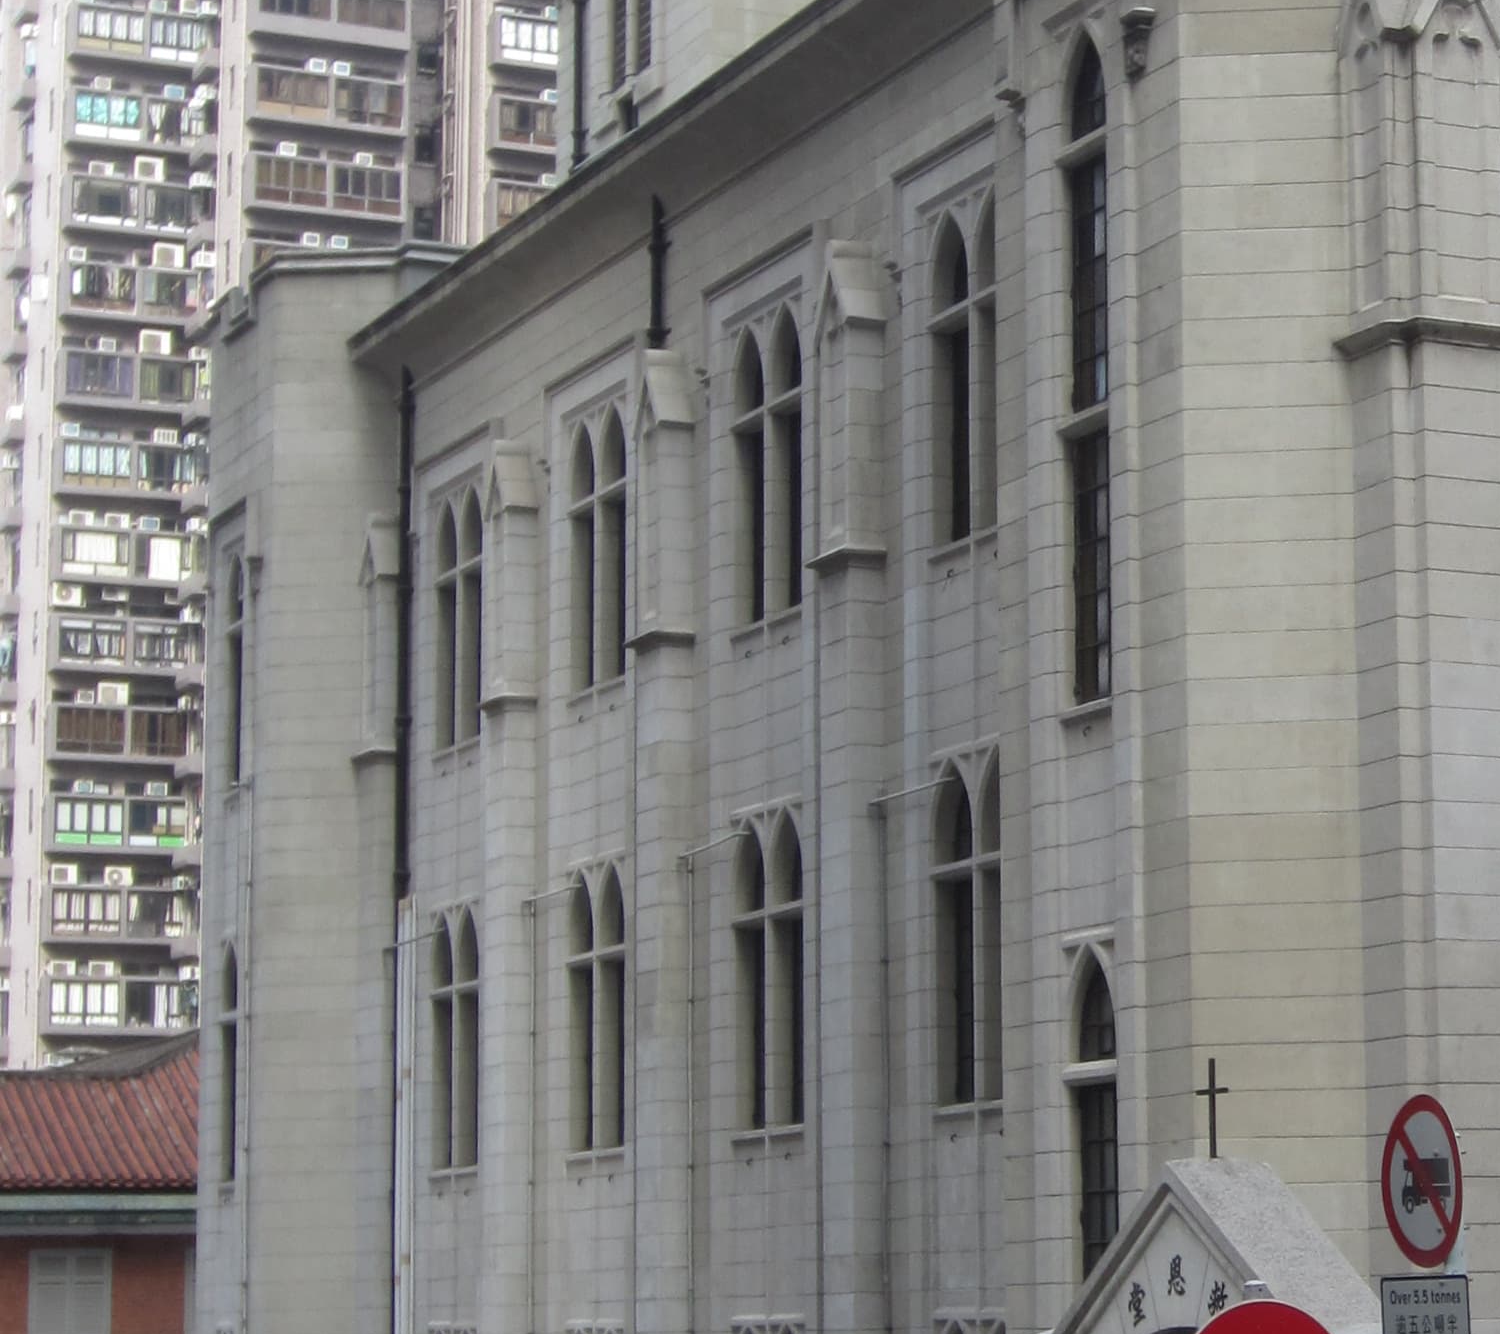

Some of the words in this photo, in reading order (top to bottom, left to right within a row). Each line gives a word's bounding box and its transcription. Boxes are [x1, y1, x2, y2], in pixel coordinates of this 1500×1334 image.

[1390, 1290, 1412, 1305] Over
[1414, 1290, 1429, 1305] 5.5
[1431, 1290, 1461, 1305] tonnes
